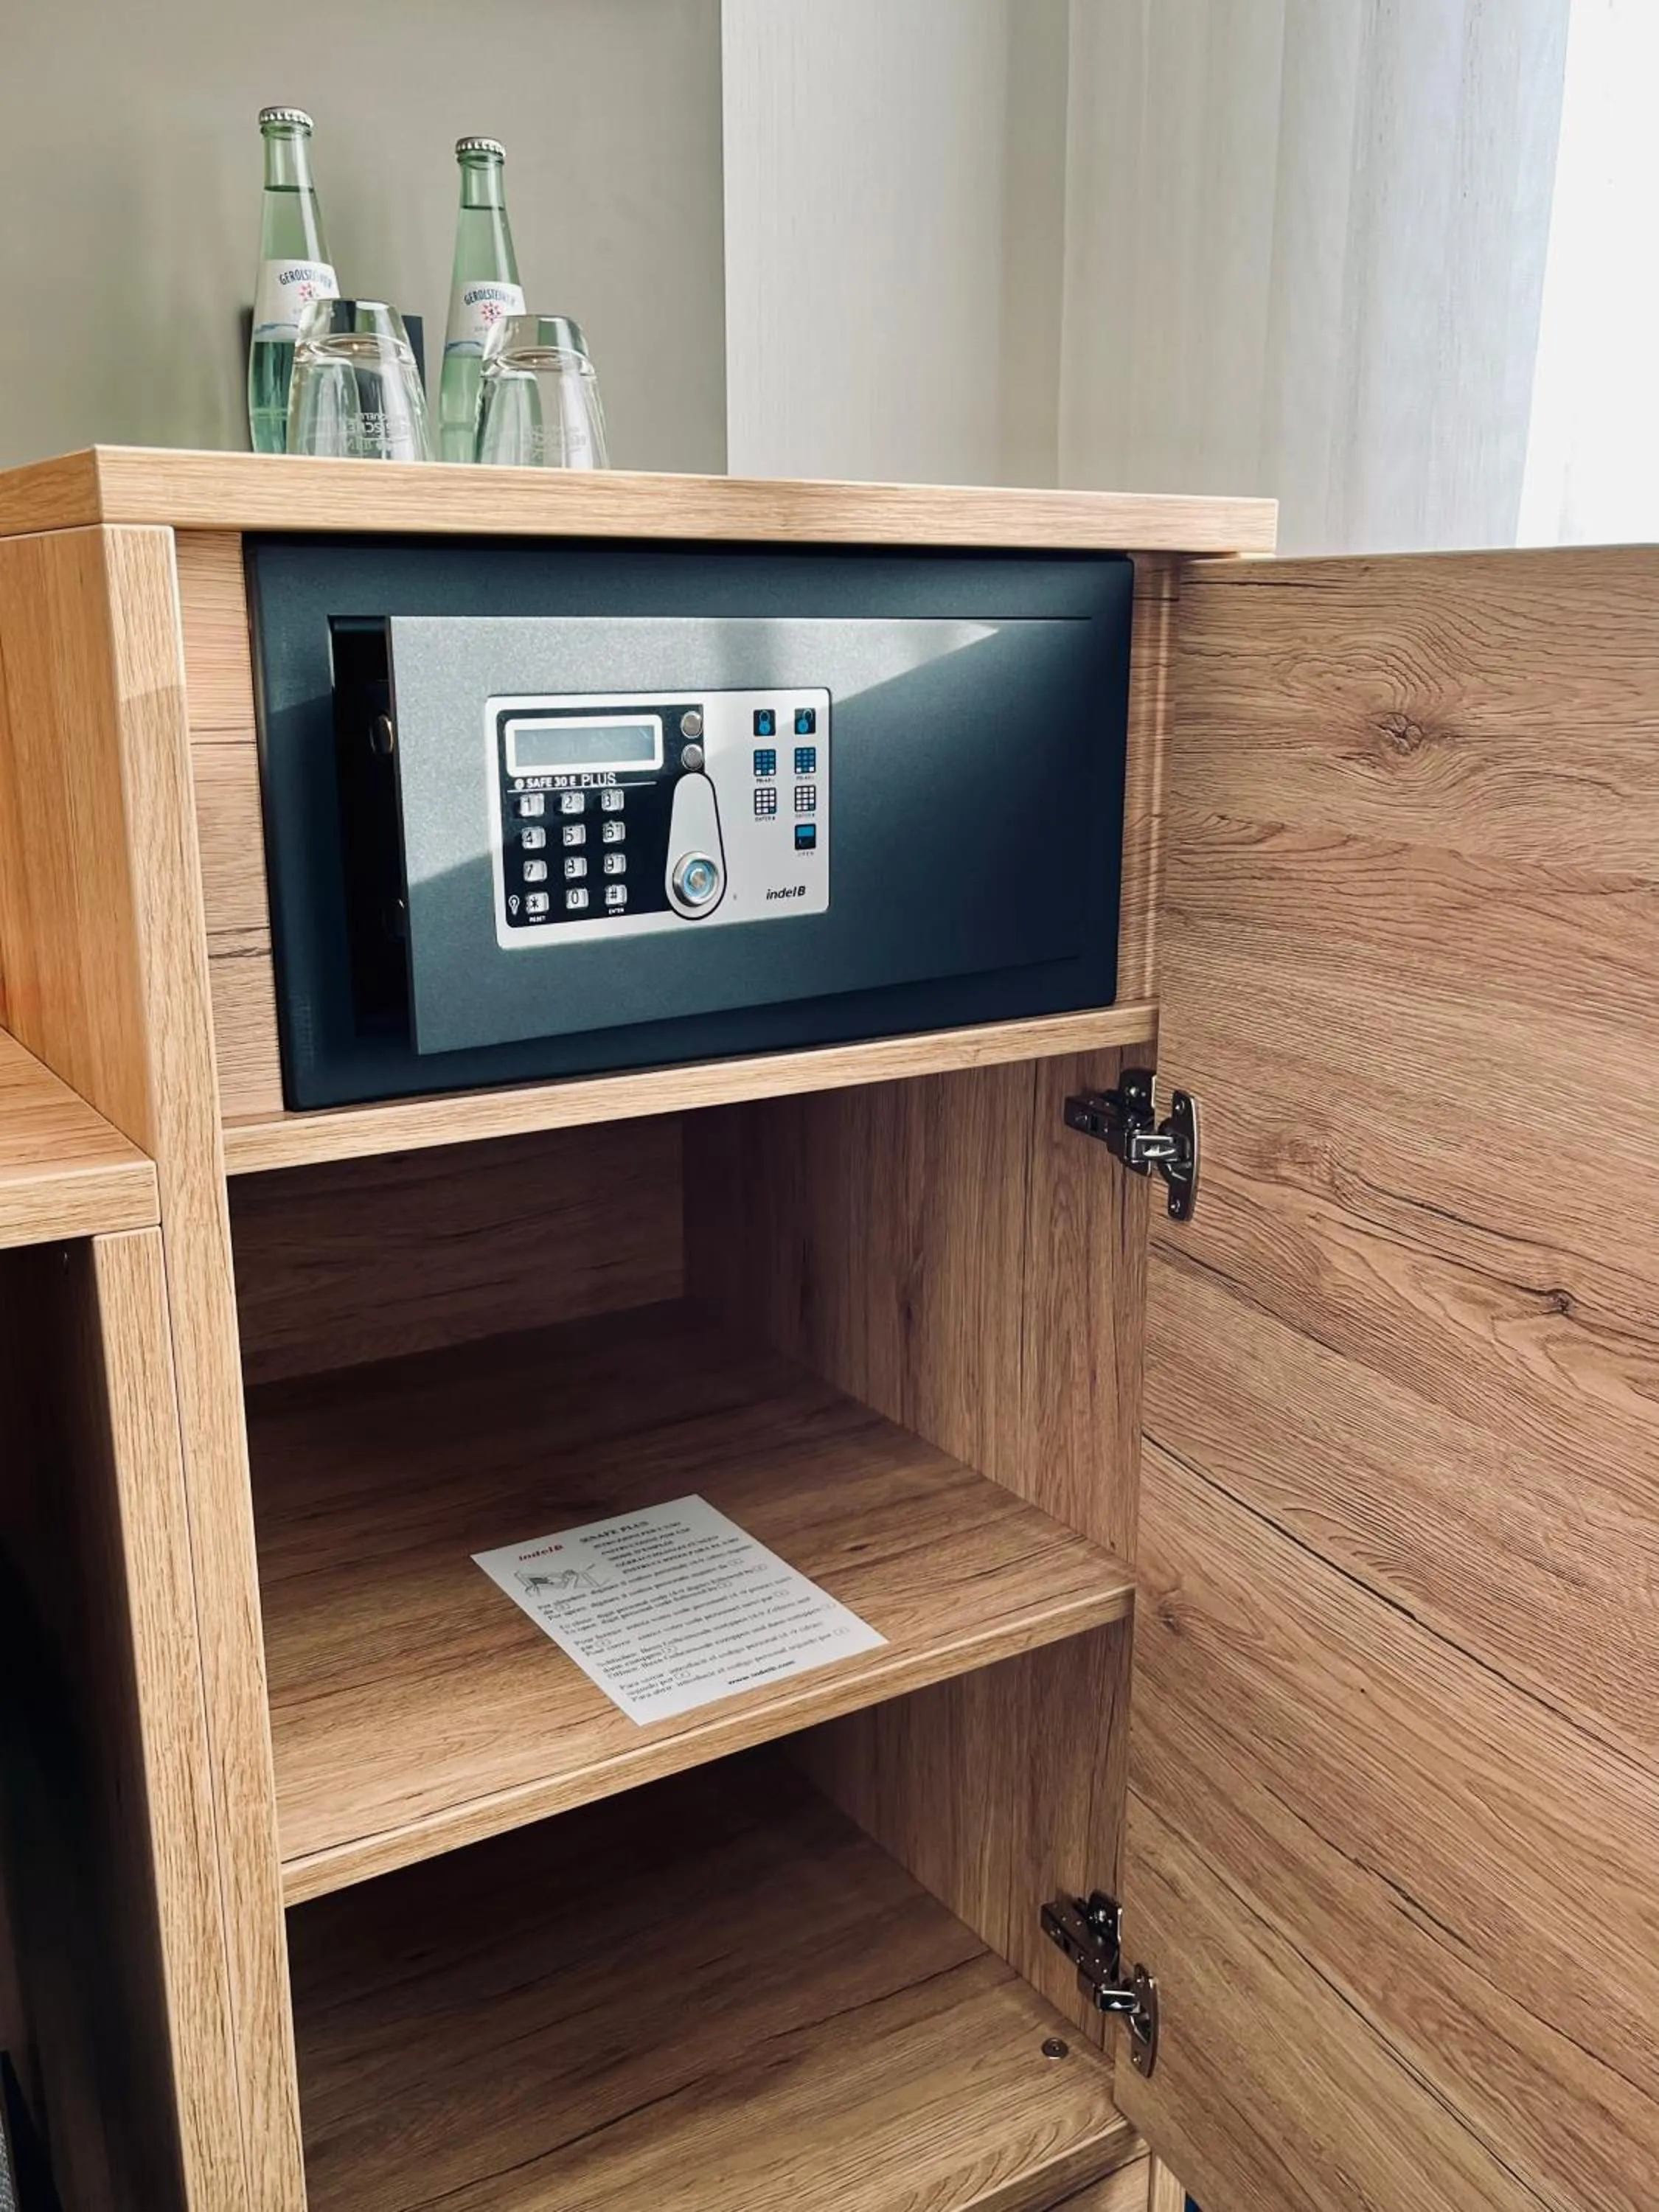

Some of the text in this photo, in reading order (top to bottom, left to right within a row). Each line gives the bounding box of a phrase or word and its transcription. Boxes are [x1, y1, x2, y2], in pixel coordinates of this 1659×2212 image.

[526, 772, 616, 787] SAFE 30 E PLUS
